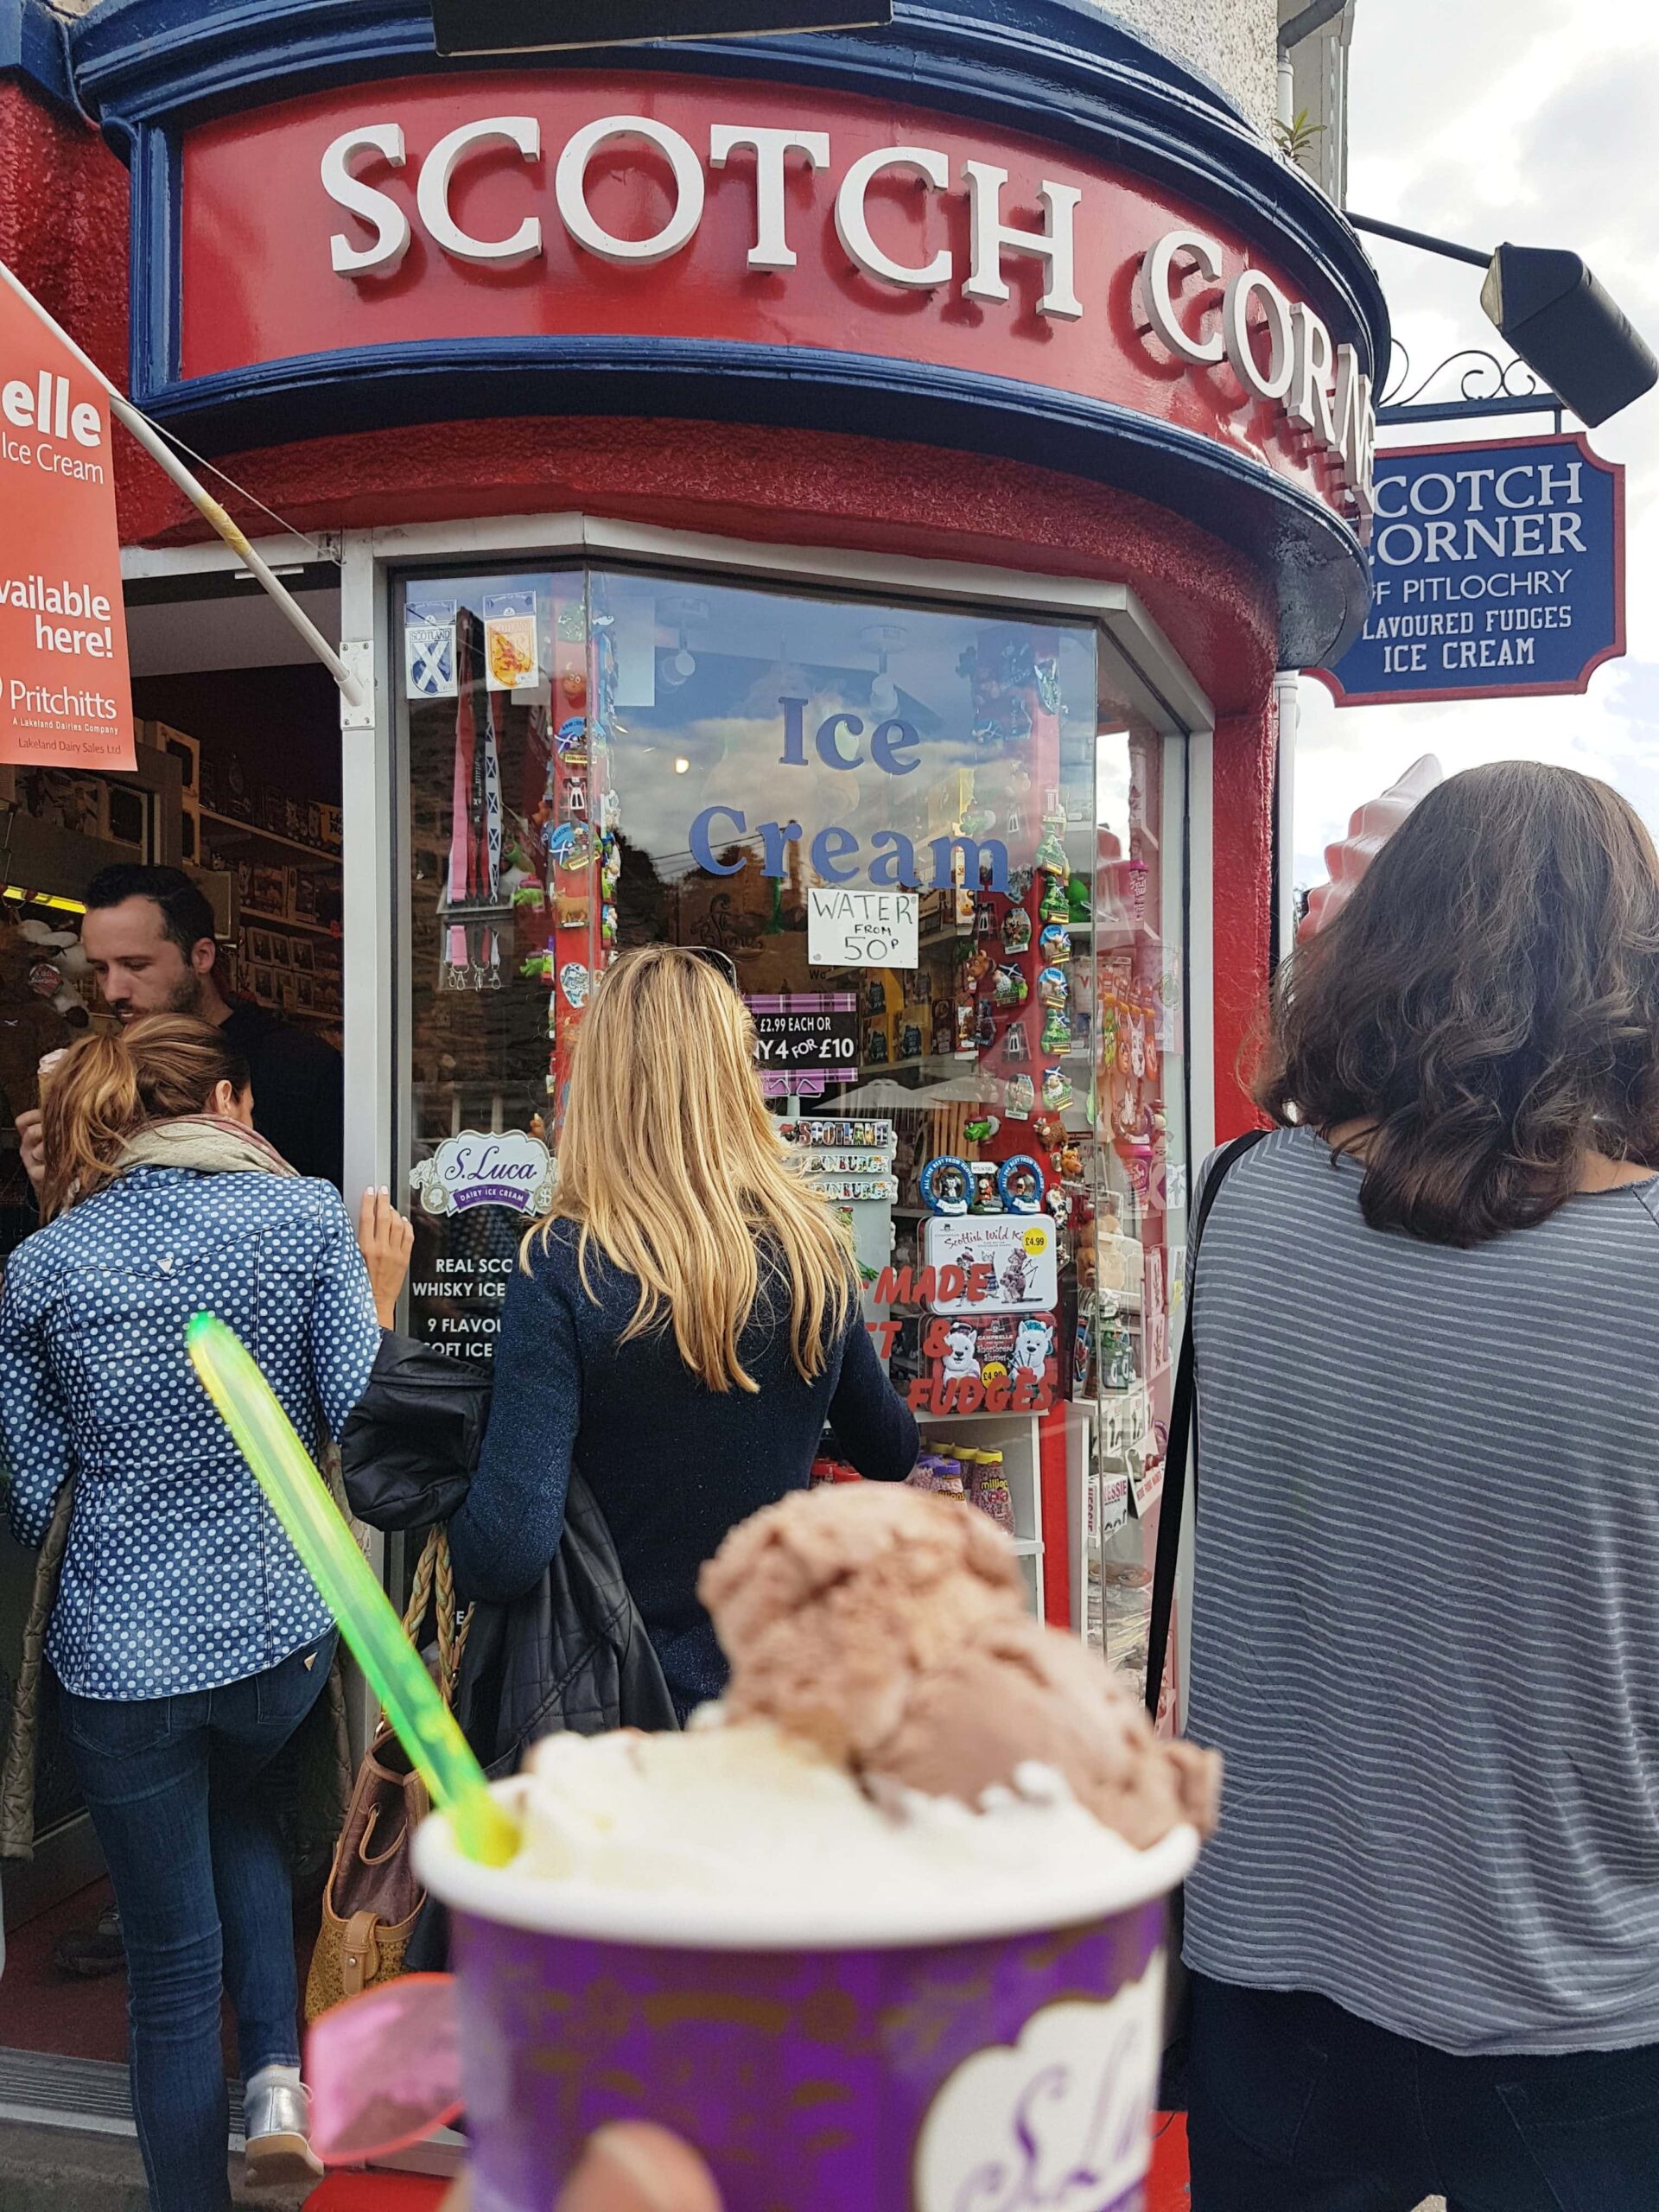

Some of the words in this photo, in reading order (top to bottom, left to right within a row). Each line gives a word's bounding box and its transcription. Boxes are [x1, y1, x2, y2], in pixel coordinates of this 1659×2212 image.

[320, 115, 1084, 322] SCOTCH
[2, 434, 31, 465] Ice
[36, 443, 104, 484] Cream
[1373, 461, 1583, 518] COTCH
[1369, 512, 1586, 566] ORNER
[1403, 569, 1573, 603] PITLOCHRY
[35, 613, 113, 658] here!
[411, 629, 450, 642] SCOTLAND
[1362, 612, 1474, 639] LAVOURED
[1485, 607, 1573, 632] FUDGES
[1383, 644, 1427, 673] ICE
[1442, 638, 1535, 669] CREAM
[10, 679, 118, 720] Pritchitts
[20, 720, 54, 729] Lakeland
[55, 721, 82, 731] Dairies
[85, 723, 118, 735] Company
[779, 696, 921, 775] Ice
[18, 738, 57, 751] Lakeland
[59, 741, 80, 753] Dairy
[83, 742, 105, 753] Sales
[106, 746, 121, 754] Ltd
[689, 805, 1010, 893] Cream
[812, 891, 912, 924] WATER
[855, 924, 892, 936] FROM
[760, 1018, 785, 1032] £2.99
[789, 1017, 814, 1031] EACH
[817, 1017, 831, 1031] OR
[775, 1039, 789, 1059] 4
[791, 1039, 818, 1058] FOR
[819, 1038, 855, 1058] £10
[444, 1146, 537, 1180] S.Luca
[460, 1189, 482, 1201] DAIRY
[499, 1189, 524, 1202] CREAM
[944, 1230, 982, 1249] Scottish
[986, 1225, 1009, 1241] Wild
[1025, 1236, 1045, 1246] £4.99
[435, 1259, 474, 1272] REAL
[412, 1282, 473, 1296] WHISKY
[479, 1282, 505, 1296] ICE
[428, 1319, 436, 1332] 9
[923, 1319, 953, 1358] &
[466, 1342, 493, 1357] ICE
[907, 1375, 1053, 1415] FUDGES
